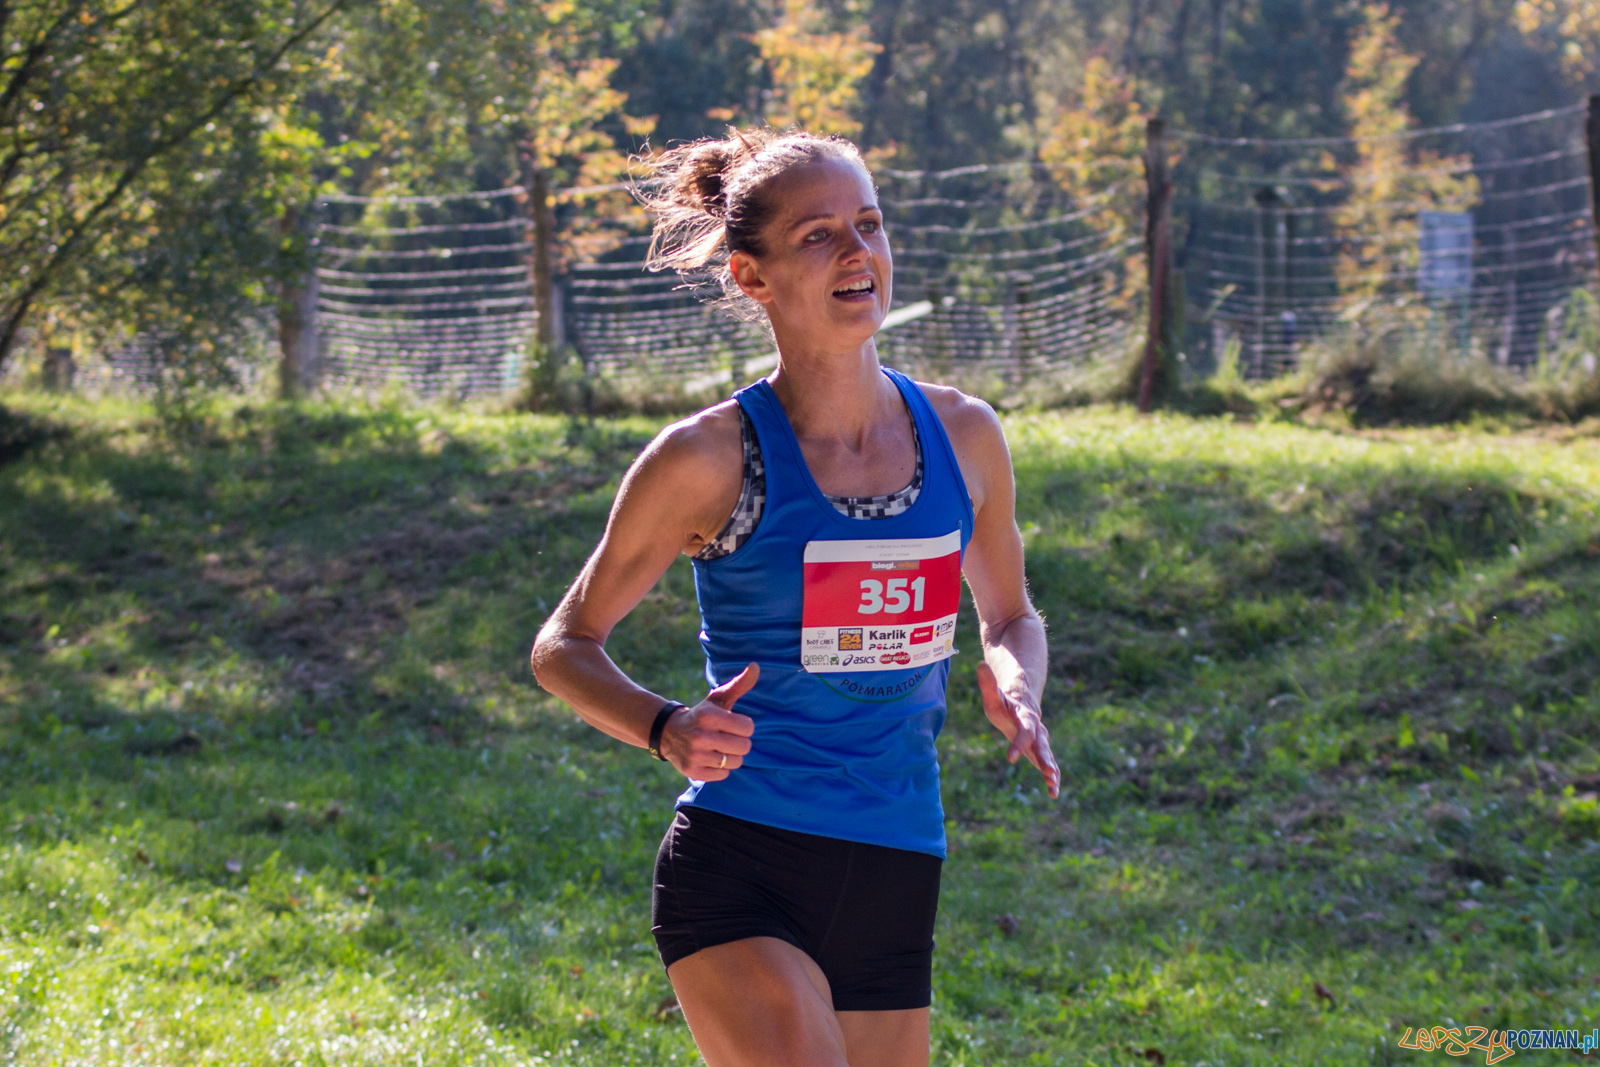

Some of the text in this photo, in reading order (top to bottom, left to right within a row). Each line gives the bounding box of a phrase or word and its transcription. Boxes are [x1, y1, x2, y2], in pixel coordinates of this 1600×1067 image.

[857, 576, 926, 615] 351
[839, 634, 862, 644] 24
[869, 629, 906, 640] Karlik
[868, 643, 903, 651] POLAR
[803, 654, 829, 666] green
[840, 671, 922, 696] PÓŁMARATON
